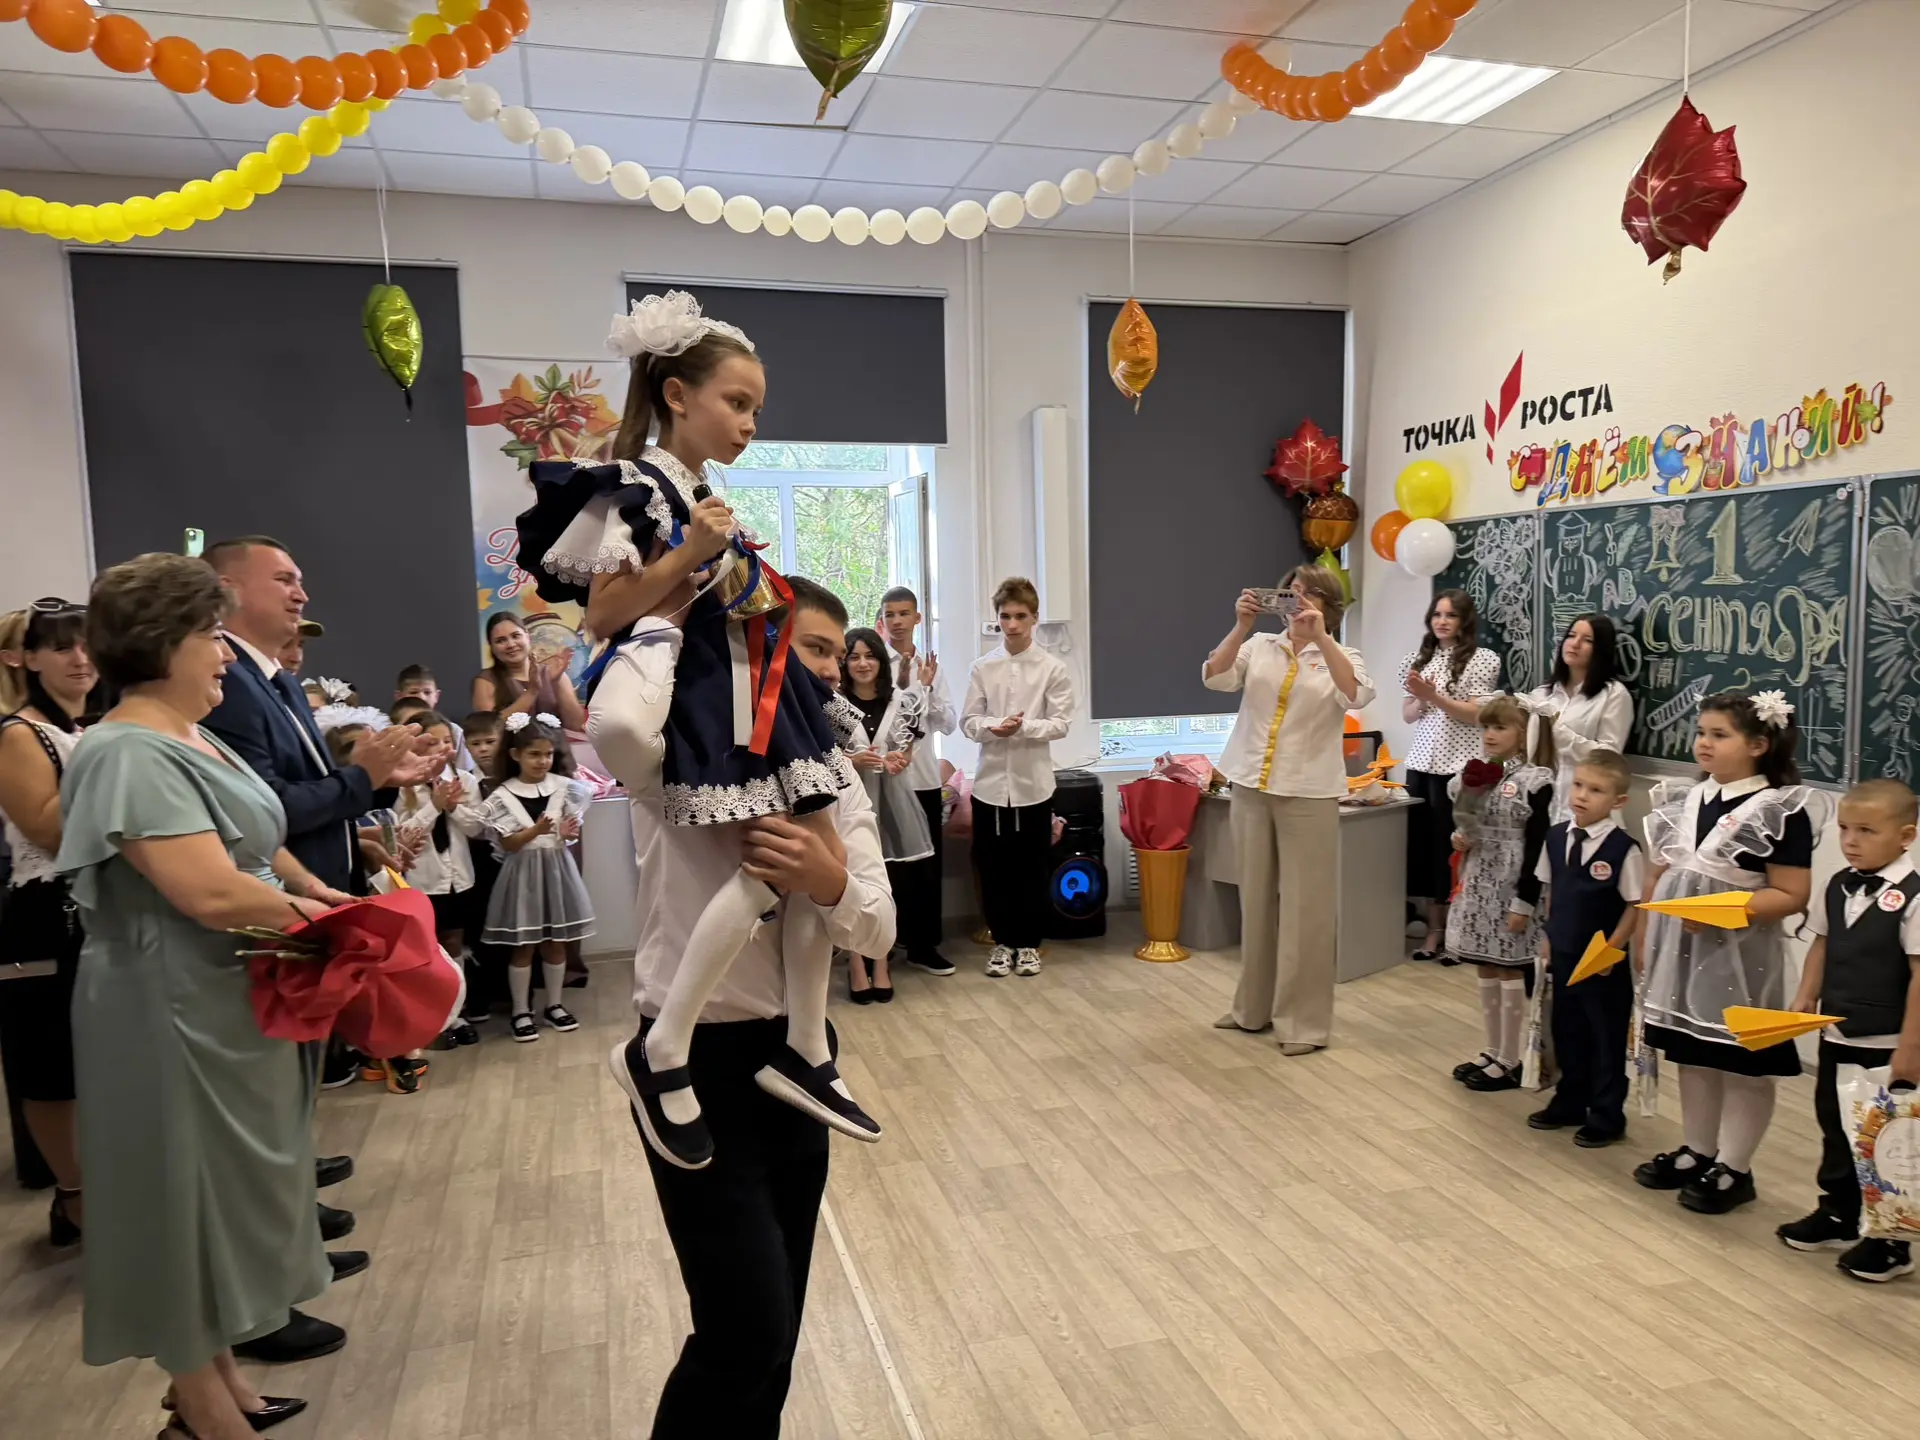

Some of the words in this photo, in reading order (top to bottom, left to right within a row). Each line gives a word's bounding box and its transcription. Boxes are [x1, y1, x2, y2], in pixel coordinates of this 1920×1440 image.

[1402, 414, 1476, 453] ТОЧКА
[1520, 383, 1613, 429] РОСТА
[1701, 499, 1744, 585] 1
